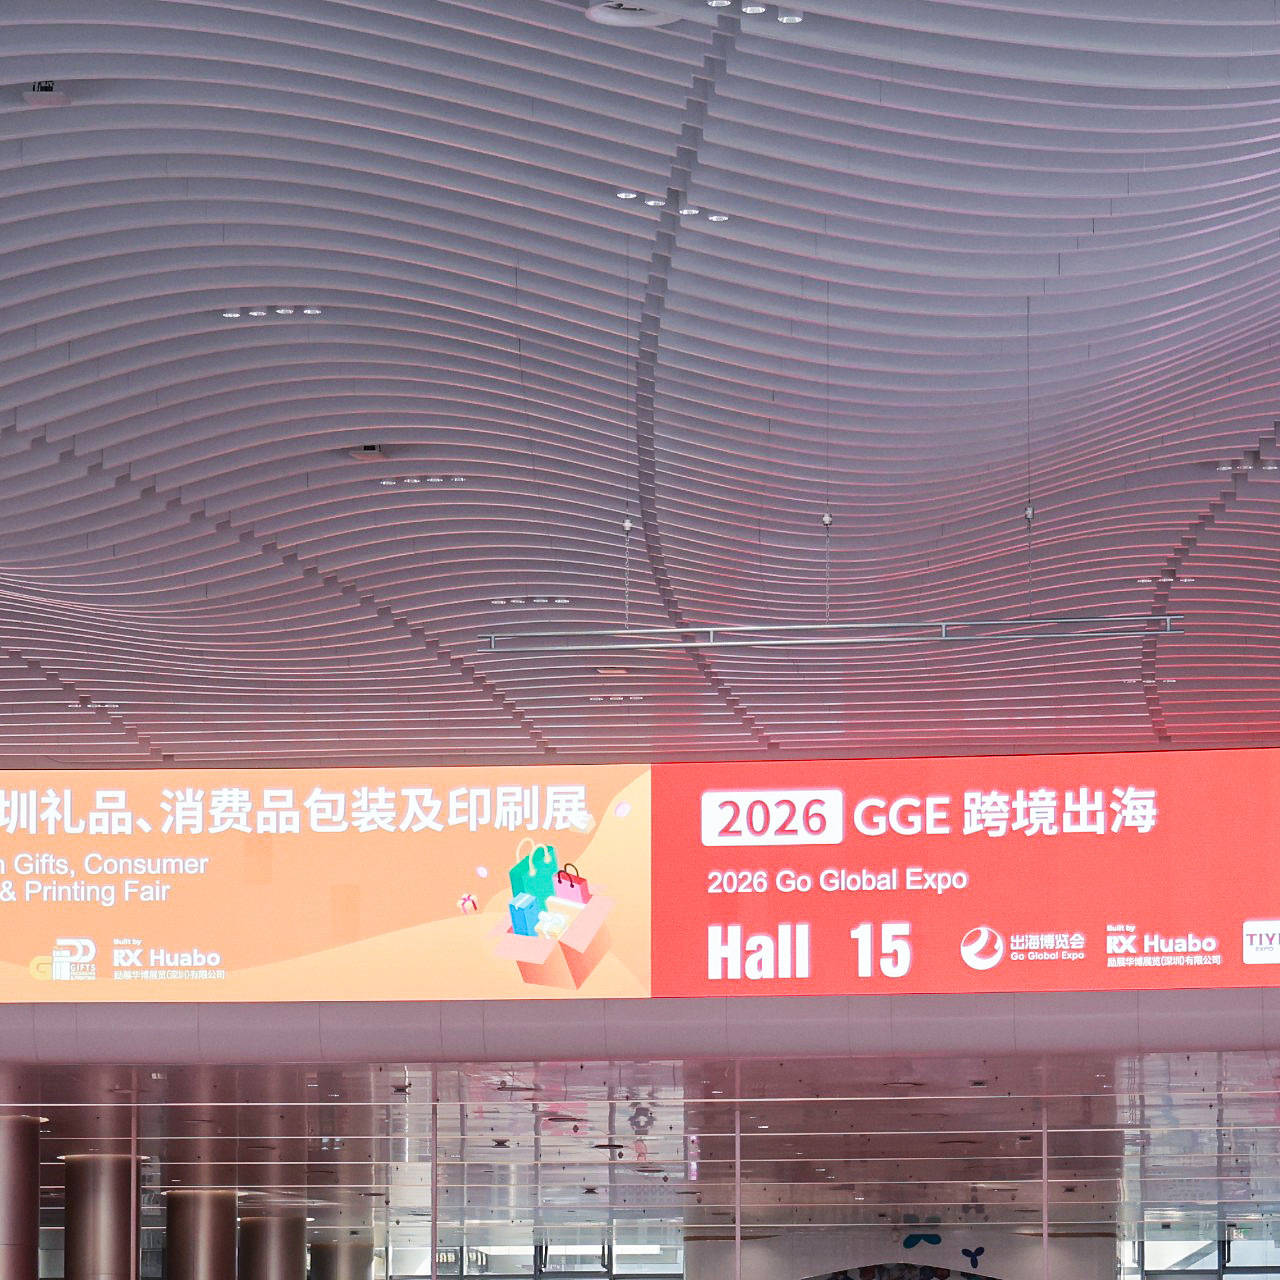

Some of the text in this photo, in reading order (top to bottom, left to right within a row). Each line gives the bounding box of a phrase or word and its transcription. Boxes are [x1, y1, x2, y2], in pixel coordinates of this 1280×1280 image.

[718, 786, 1159, 838] 2026 GGE 跨境出海
[14, 852, 76, 878] Gifts,
[84, 852, 209, 875] Consumer
[0, 880, 17, 903] &
[24, 878, 117, 908] Printing
[123, 878, 170, 902] Fair
[707, 868, 969, 897] 2026 Go Global Expo
[707, 922, 912, 981] Hall 15
[1010, 933, 1085, 952] 出海博览会
[1106, 934, 1217, 955] RX Huabo
[113, 948, 221, 967] RX Huabo
[1010, 951, 1085, 962] Go Global Expo
